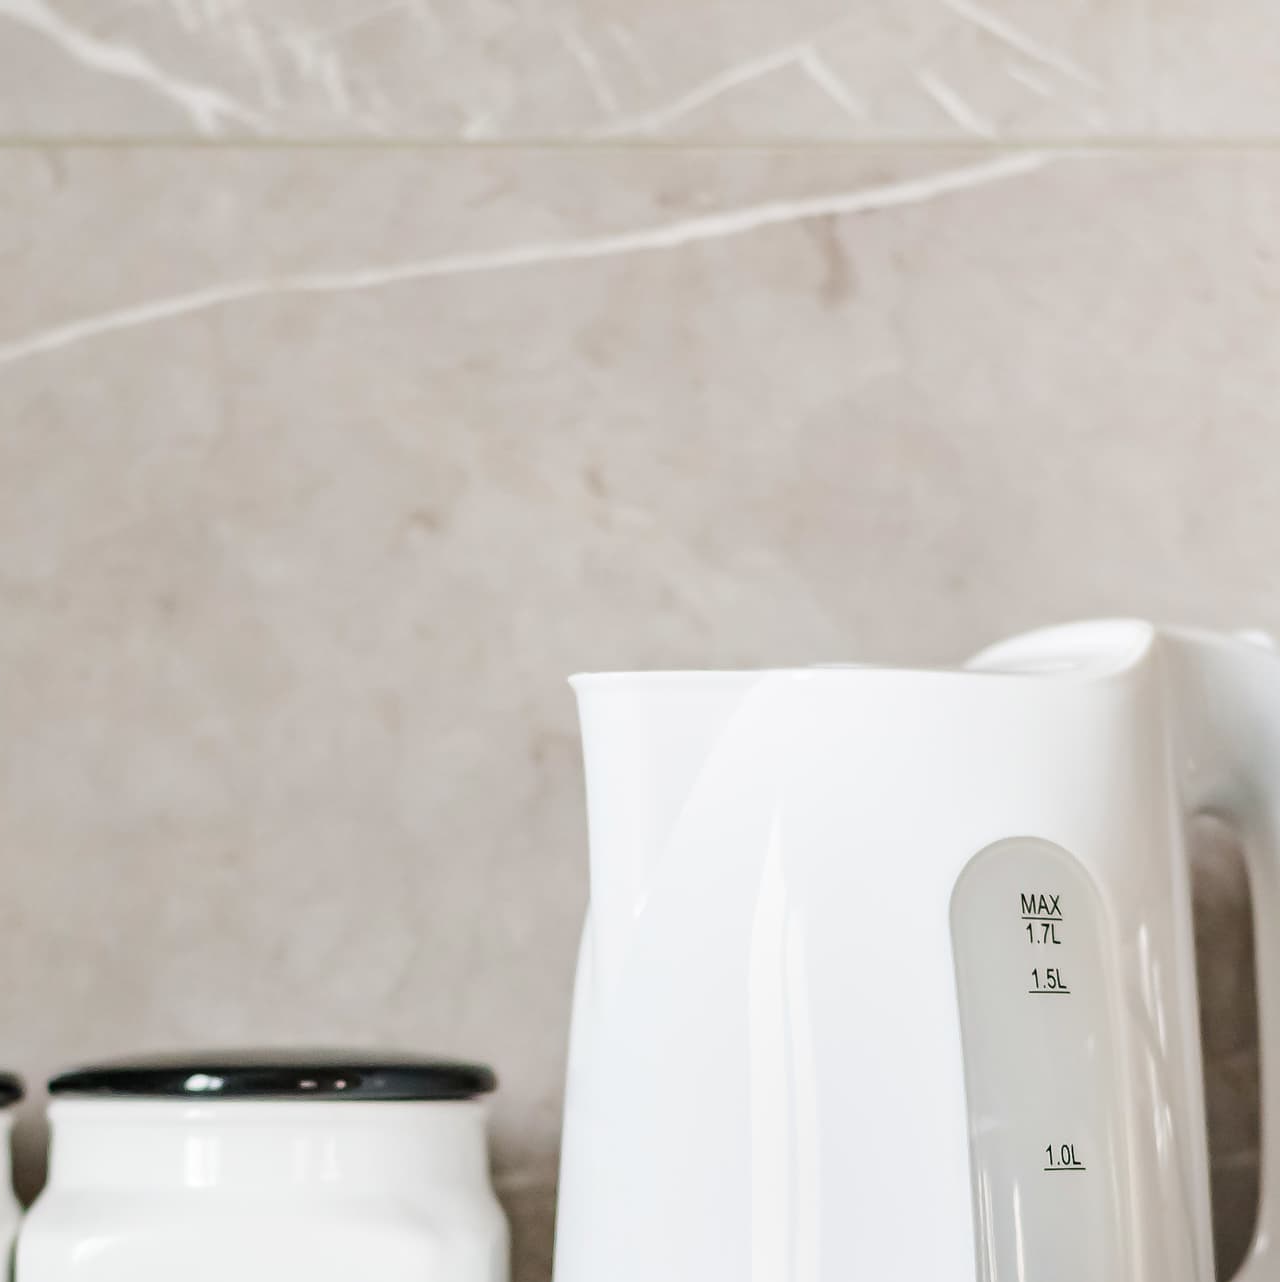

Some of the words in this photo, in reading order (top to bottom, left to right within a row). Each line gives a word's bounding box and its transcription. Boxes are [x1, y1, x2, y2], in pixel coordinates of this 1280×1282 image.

[1020, 893, 1063, 916] MAX
[1025, 923, 1062, 945] 1.7L
[1031, 968, 1067, 990] 1.5L
[1045, 1144, 1081, 1167] 1.0L
